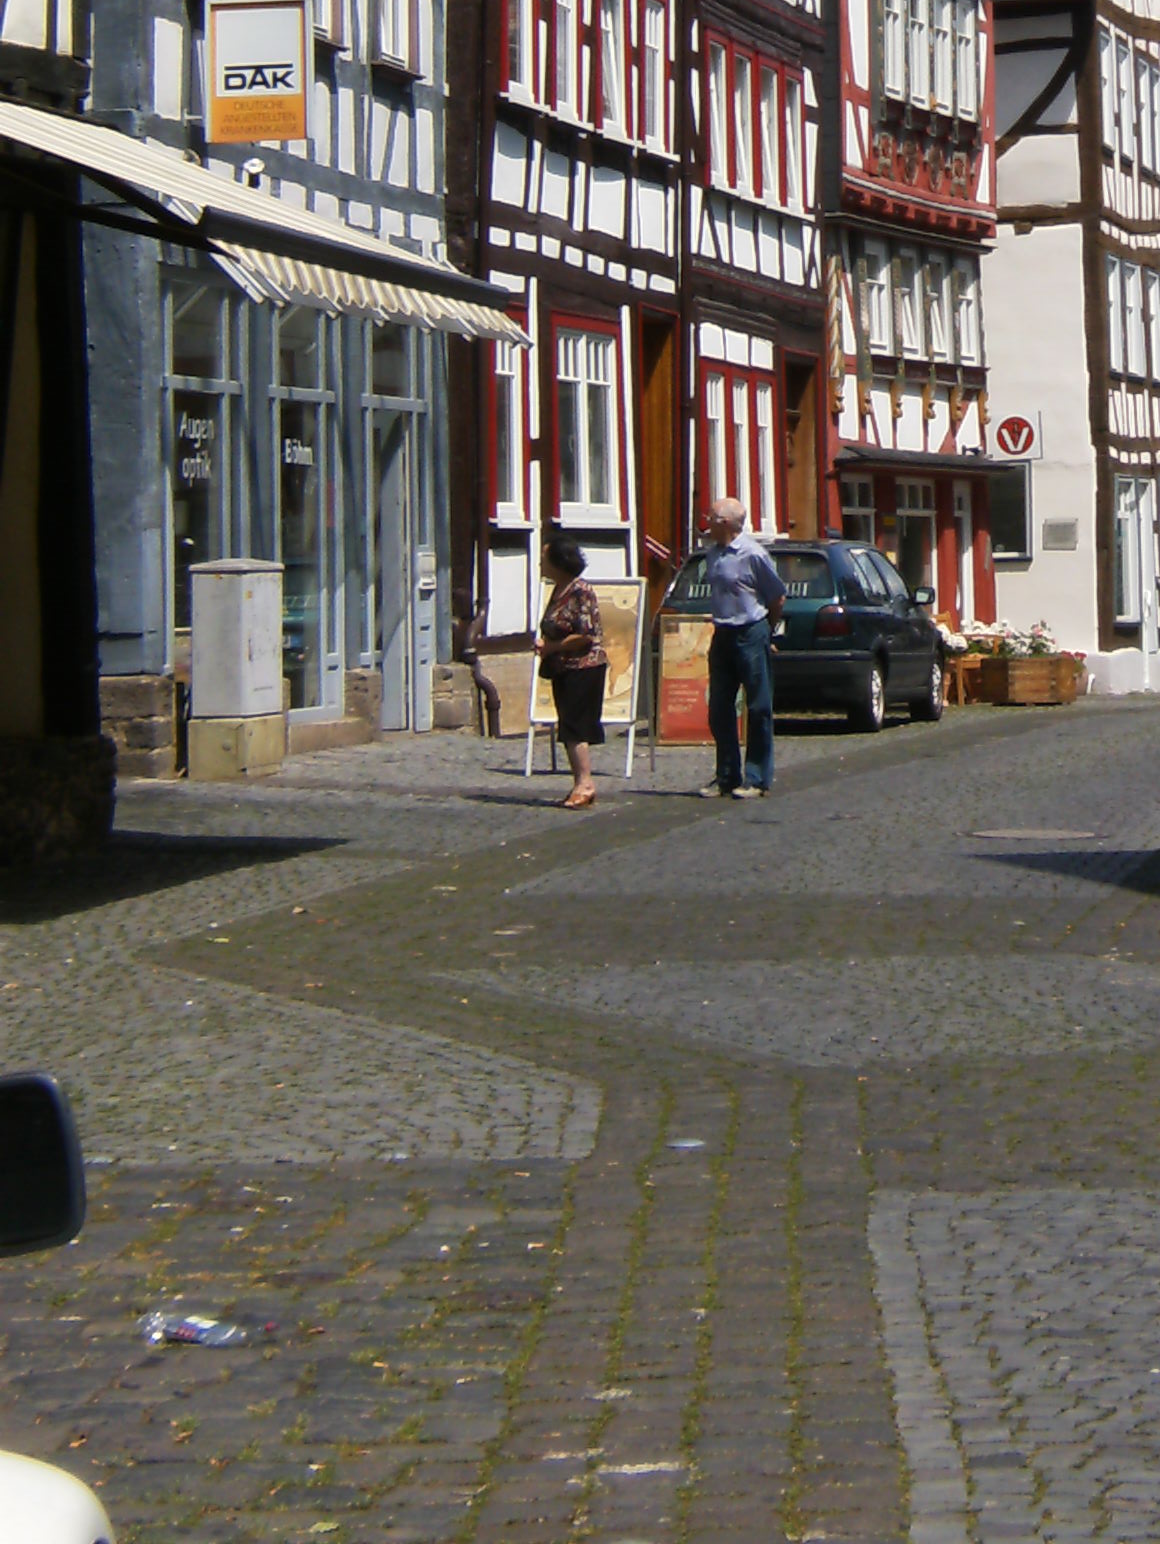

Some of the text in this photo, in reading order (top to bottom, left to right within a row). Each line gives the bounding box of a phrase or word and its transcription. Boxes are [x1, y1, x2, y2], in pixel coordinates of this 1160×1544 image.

[224, 63, 294, 91] DAK
[179, 411, 215, 449] Augen
[284, 437, 314, 466] Böhm
[182, 449, 212, 489] optik
